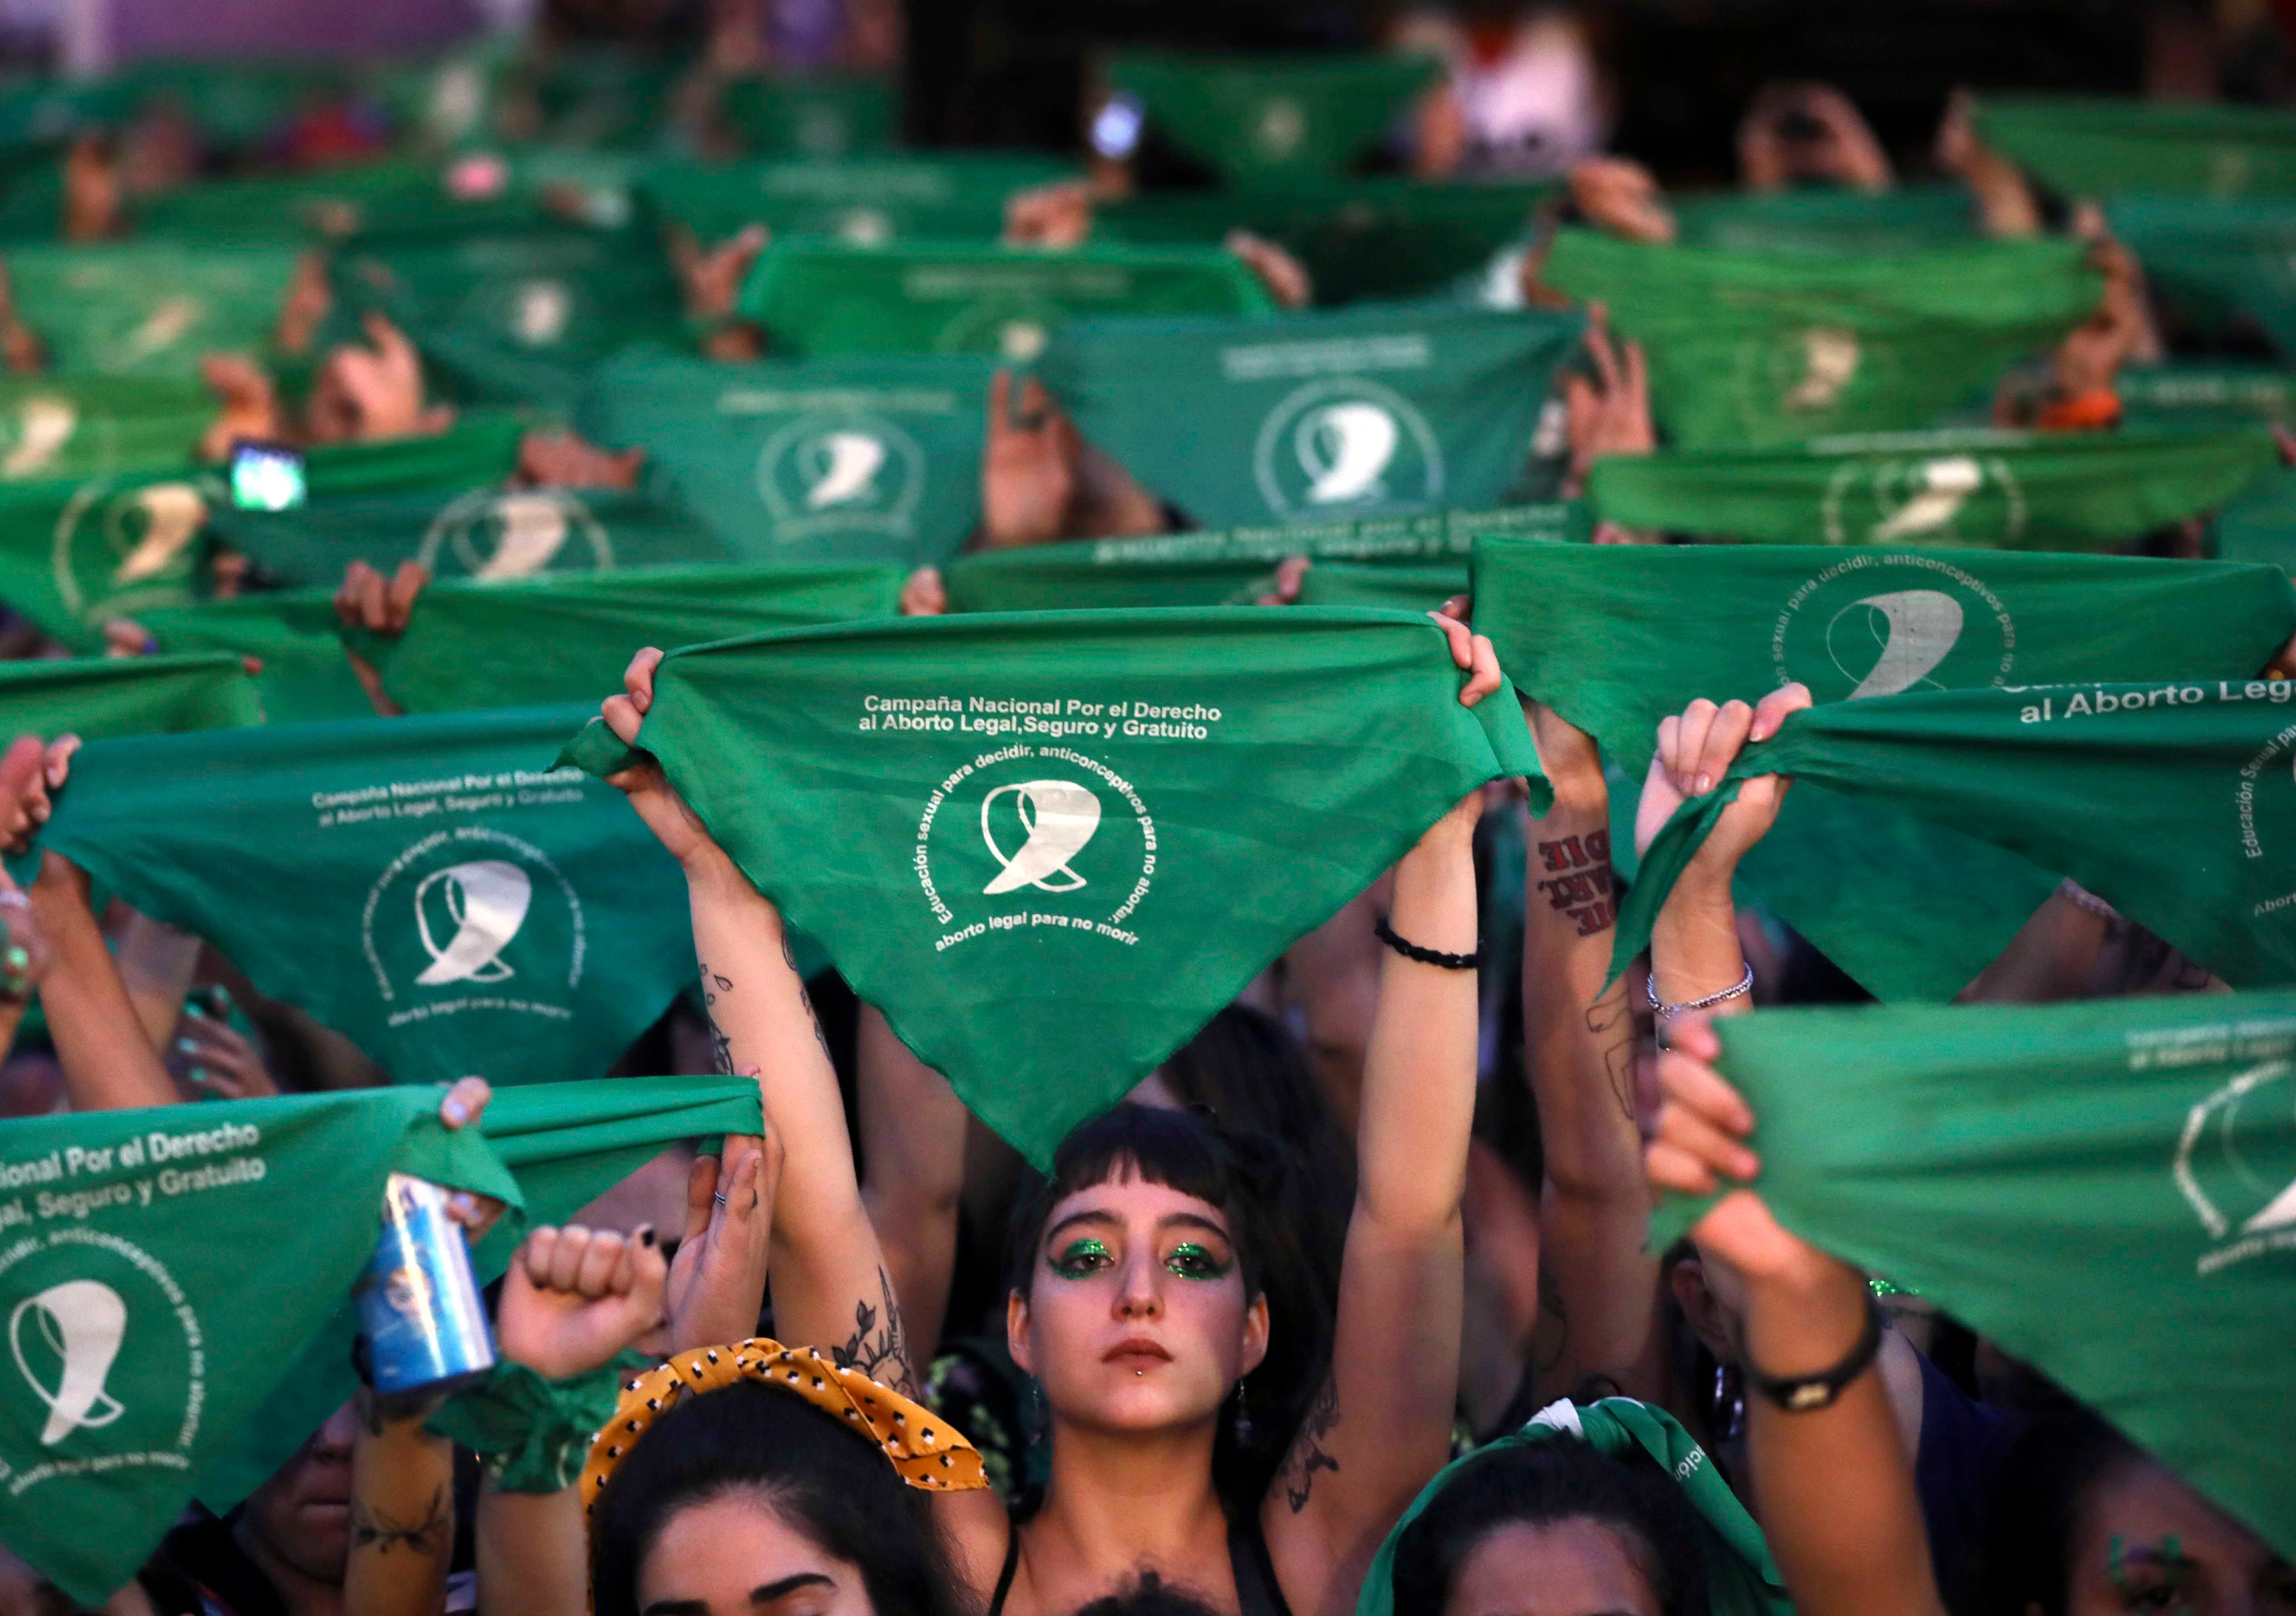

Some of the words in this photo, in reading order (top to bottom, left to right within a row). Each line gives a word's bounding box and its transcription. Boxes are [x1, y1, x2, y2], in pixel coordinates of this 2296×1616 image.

[863, 695, 963, 714] Campaña
[969, 696, 1061, 716] Nacional
[1066, 699, 1104, 716] Por
[1108, 701, 1128, 717] el
[1133, 702, 1222, 721] Derecho
[2020, 698, 2052, 724] al
[2063, 685, 2204, 719] Aborto
[2218, 680, 2296, 704] Leg
[858, 713, 877, 730] al
[882, 713, 955, 731] Aborto
[1103, 722, 1117, 739] y
[1123, 719, 1208, 740] Gratuito
[975, 741, 1034, 769] decidir,
[941, 764, 974, 794] para
[1039, 746, 1147, 814] anticonceptivos
[917, 789, 945, 841] sexual
[1137, 815, 1157, 851] para
[2235, 781, 2263, 859] Educación
[913, 844, 954, 925] Educación
[1143, 854, 1156, 875] no
[935, 922, 986, 952] aborto
[988, 911, 1027, 930] legal
[1031, 912, 1069, 927] para
[1071, 917, 1093, 930] no
[1096, 922, 1140, 946] morir
[64, 1145, 114, 1176] Por
[119, 1135, 146, 1168] el
[147, 1121, 260, 1163] Derecho
[36, 1181, 131, 1219] Seguro
[134, 1177, 152, 1207] y
[158, 1156, 267, 1196] Gratuito
